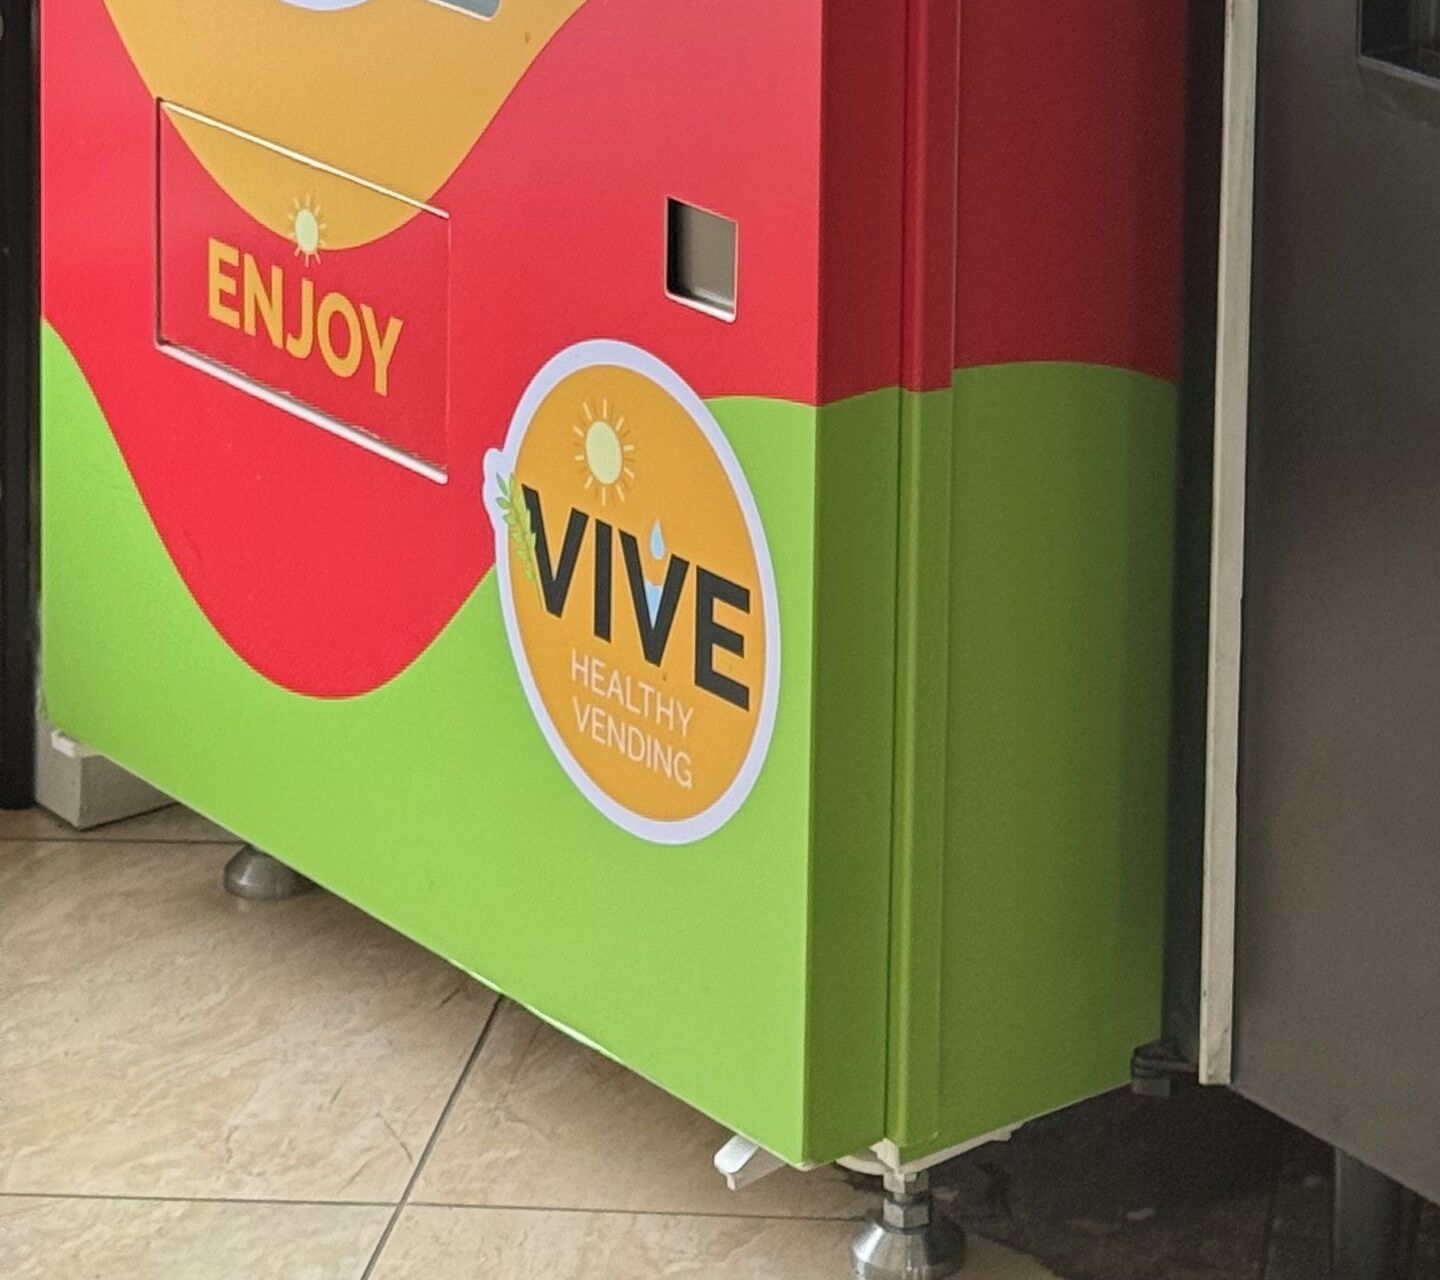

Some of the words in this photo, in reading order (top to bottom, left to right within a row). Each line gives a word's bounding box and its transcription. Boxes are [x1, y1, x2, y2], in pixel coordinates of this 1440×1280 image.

[207, 237, 404, 397] ENJOY
[520, 483, 751, 713] VIVE
[570, 648, 695, 739] HEALTHY
[571, 695, 693, 790] VENDING
